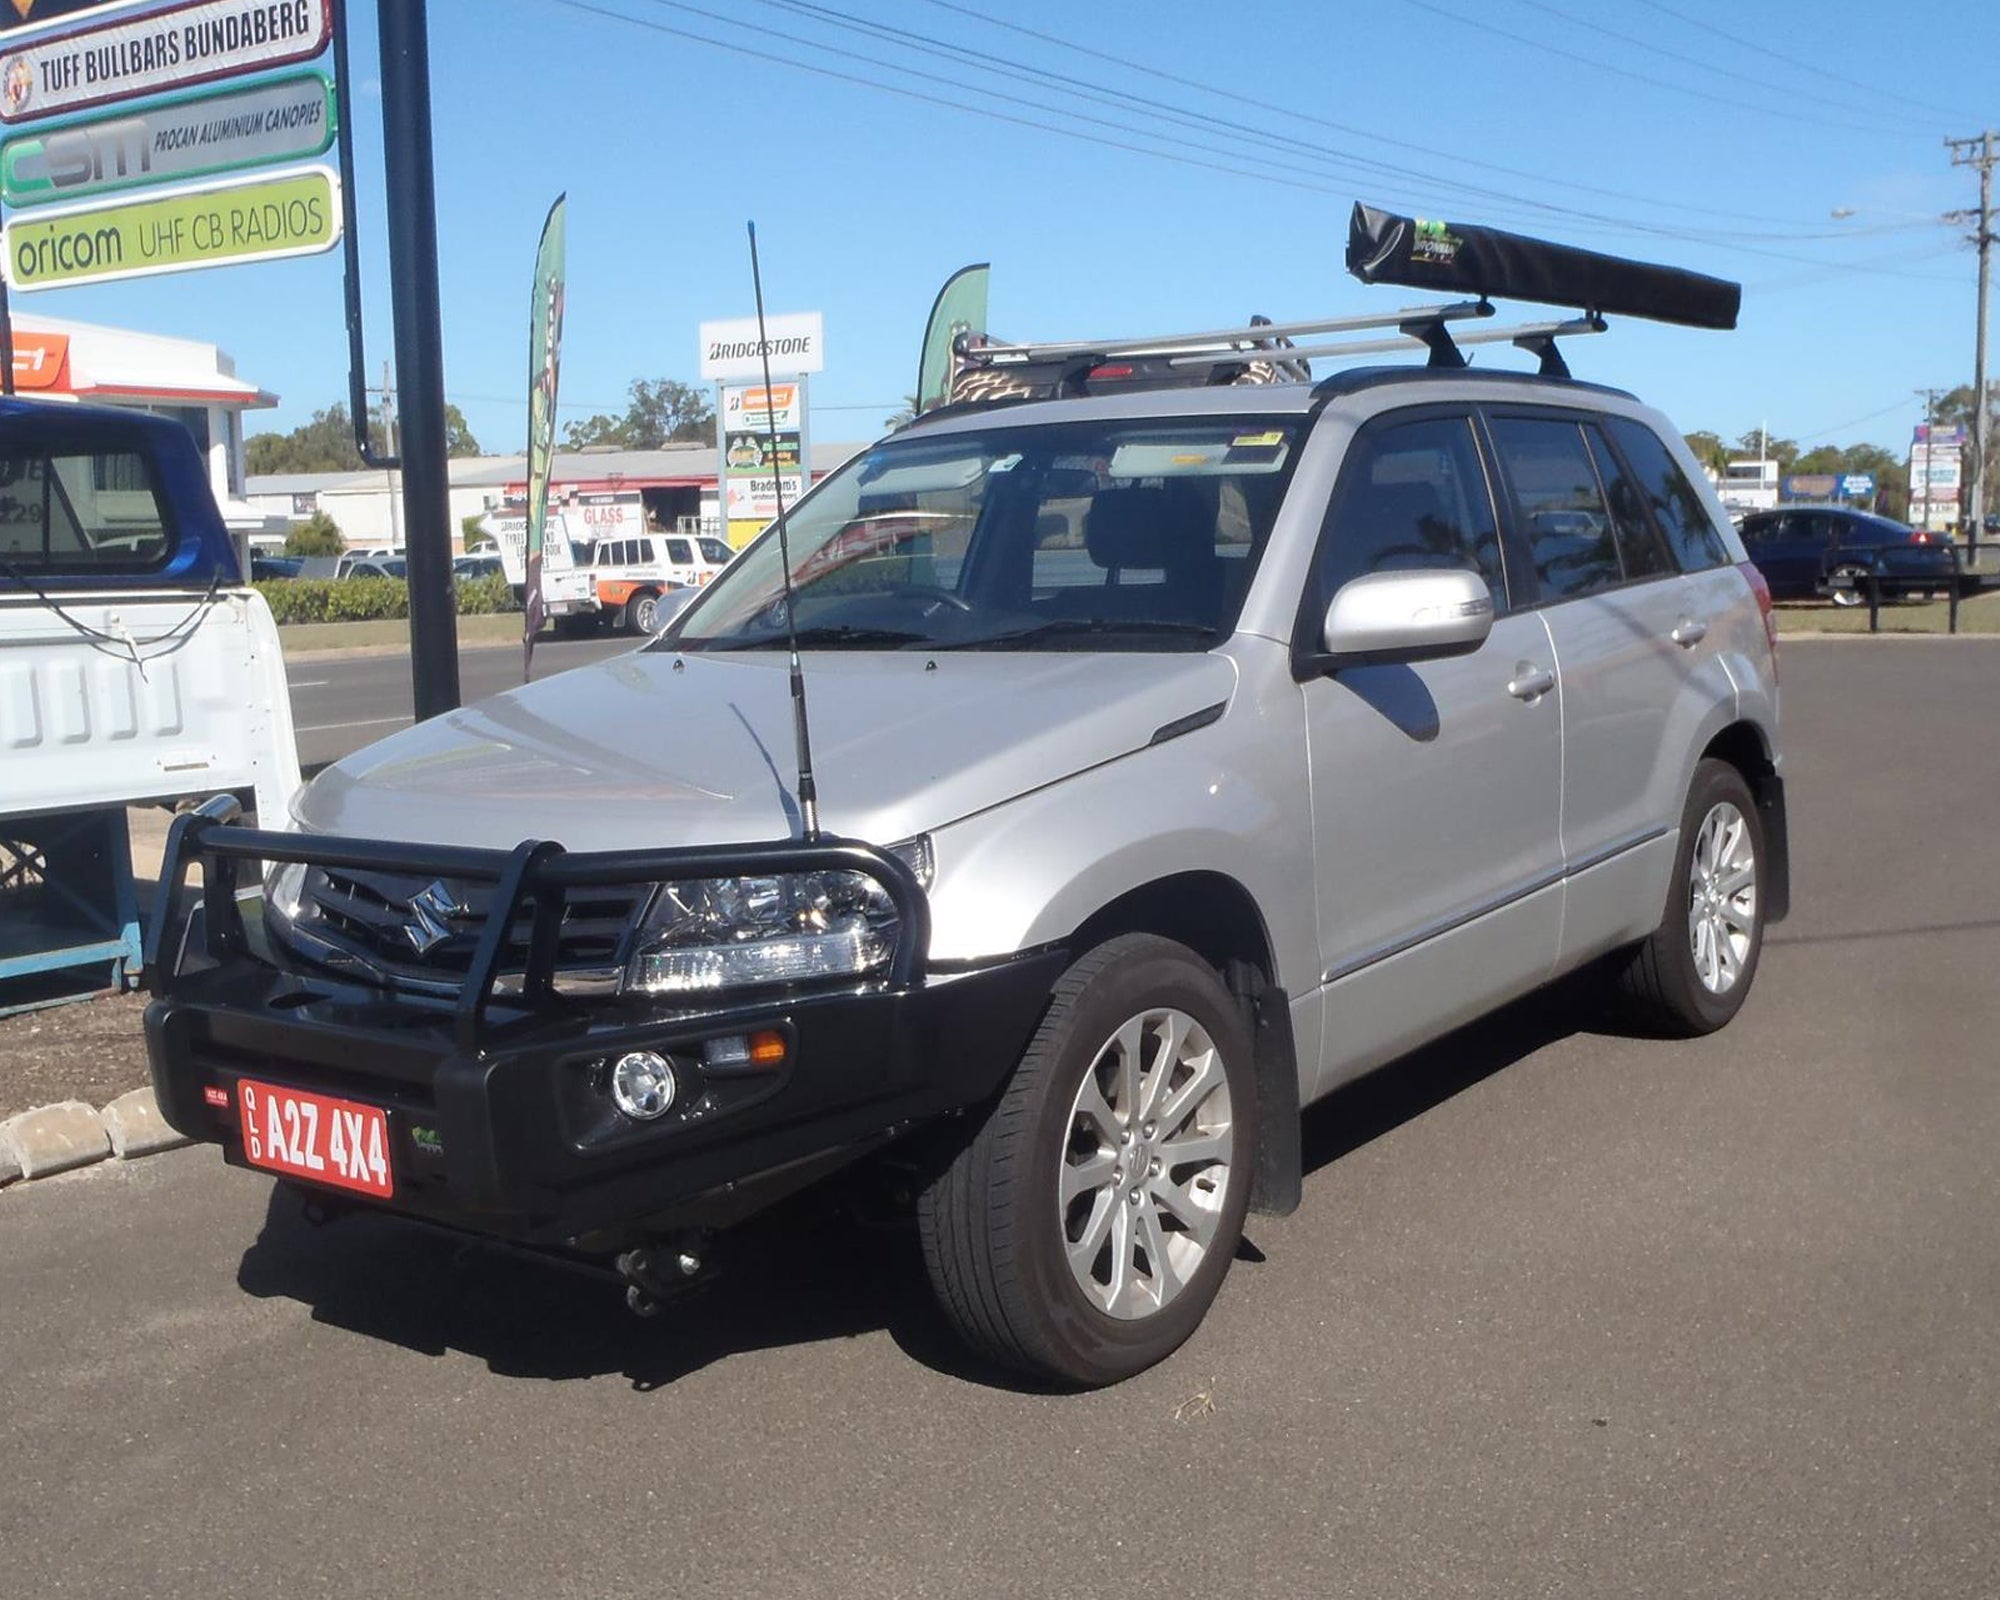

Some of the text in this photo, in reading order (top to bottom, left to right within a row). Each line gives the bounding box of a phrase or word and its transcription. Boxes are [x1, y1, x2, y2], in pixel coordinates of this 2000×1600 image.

[41, 1, 310, 93] TUFF BULLBARS BUNDABERG
[154, 128, 197, 153] PROCAN
[199, 115, 263, 145] ALUMINIUM
[264, 101, 322, 132] CANOPIES
[18, 197, 323, 277] oricom UHF CB RADIOS
[709, 336, 811, 361] BRIDGESTONE
[583, 507, 623, 526] GLASS
[245, 1086, 262, 1159] QLD
[267, 1094, 386, 1186] A2Z 4X4
